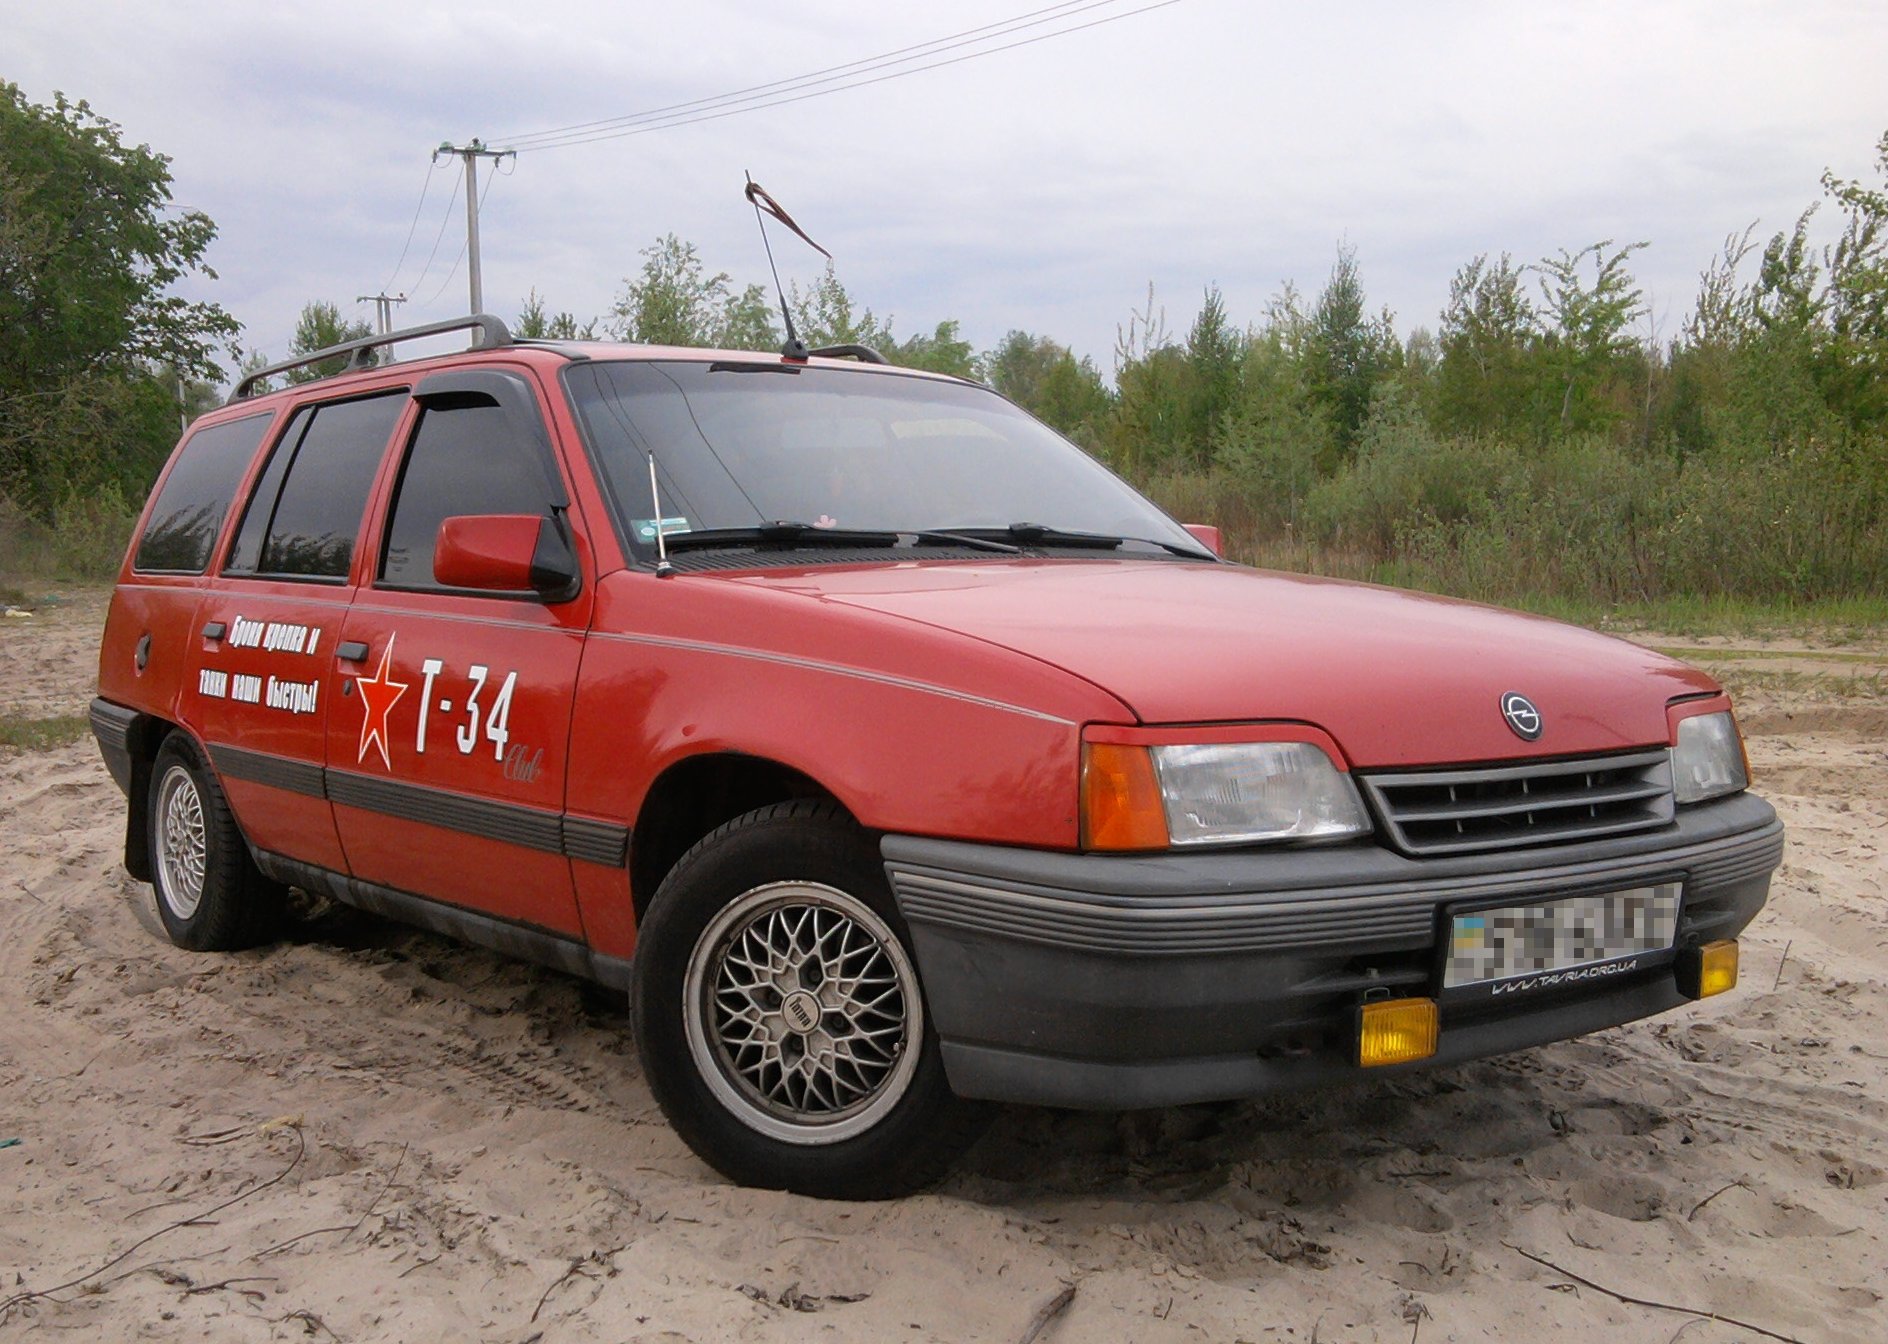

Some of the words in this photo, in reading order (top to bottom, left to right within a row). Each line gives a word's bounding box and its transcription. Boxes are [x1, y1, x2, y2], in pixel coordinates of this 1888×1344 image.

[306, 628, 321, 655] и
[232, 675, 261, 702] наши
[266, 675, 319, 713] быстры!
